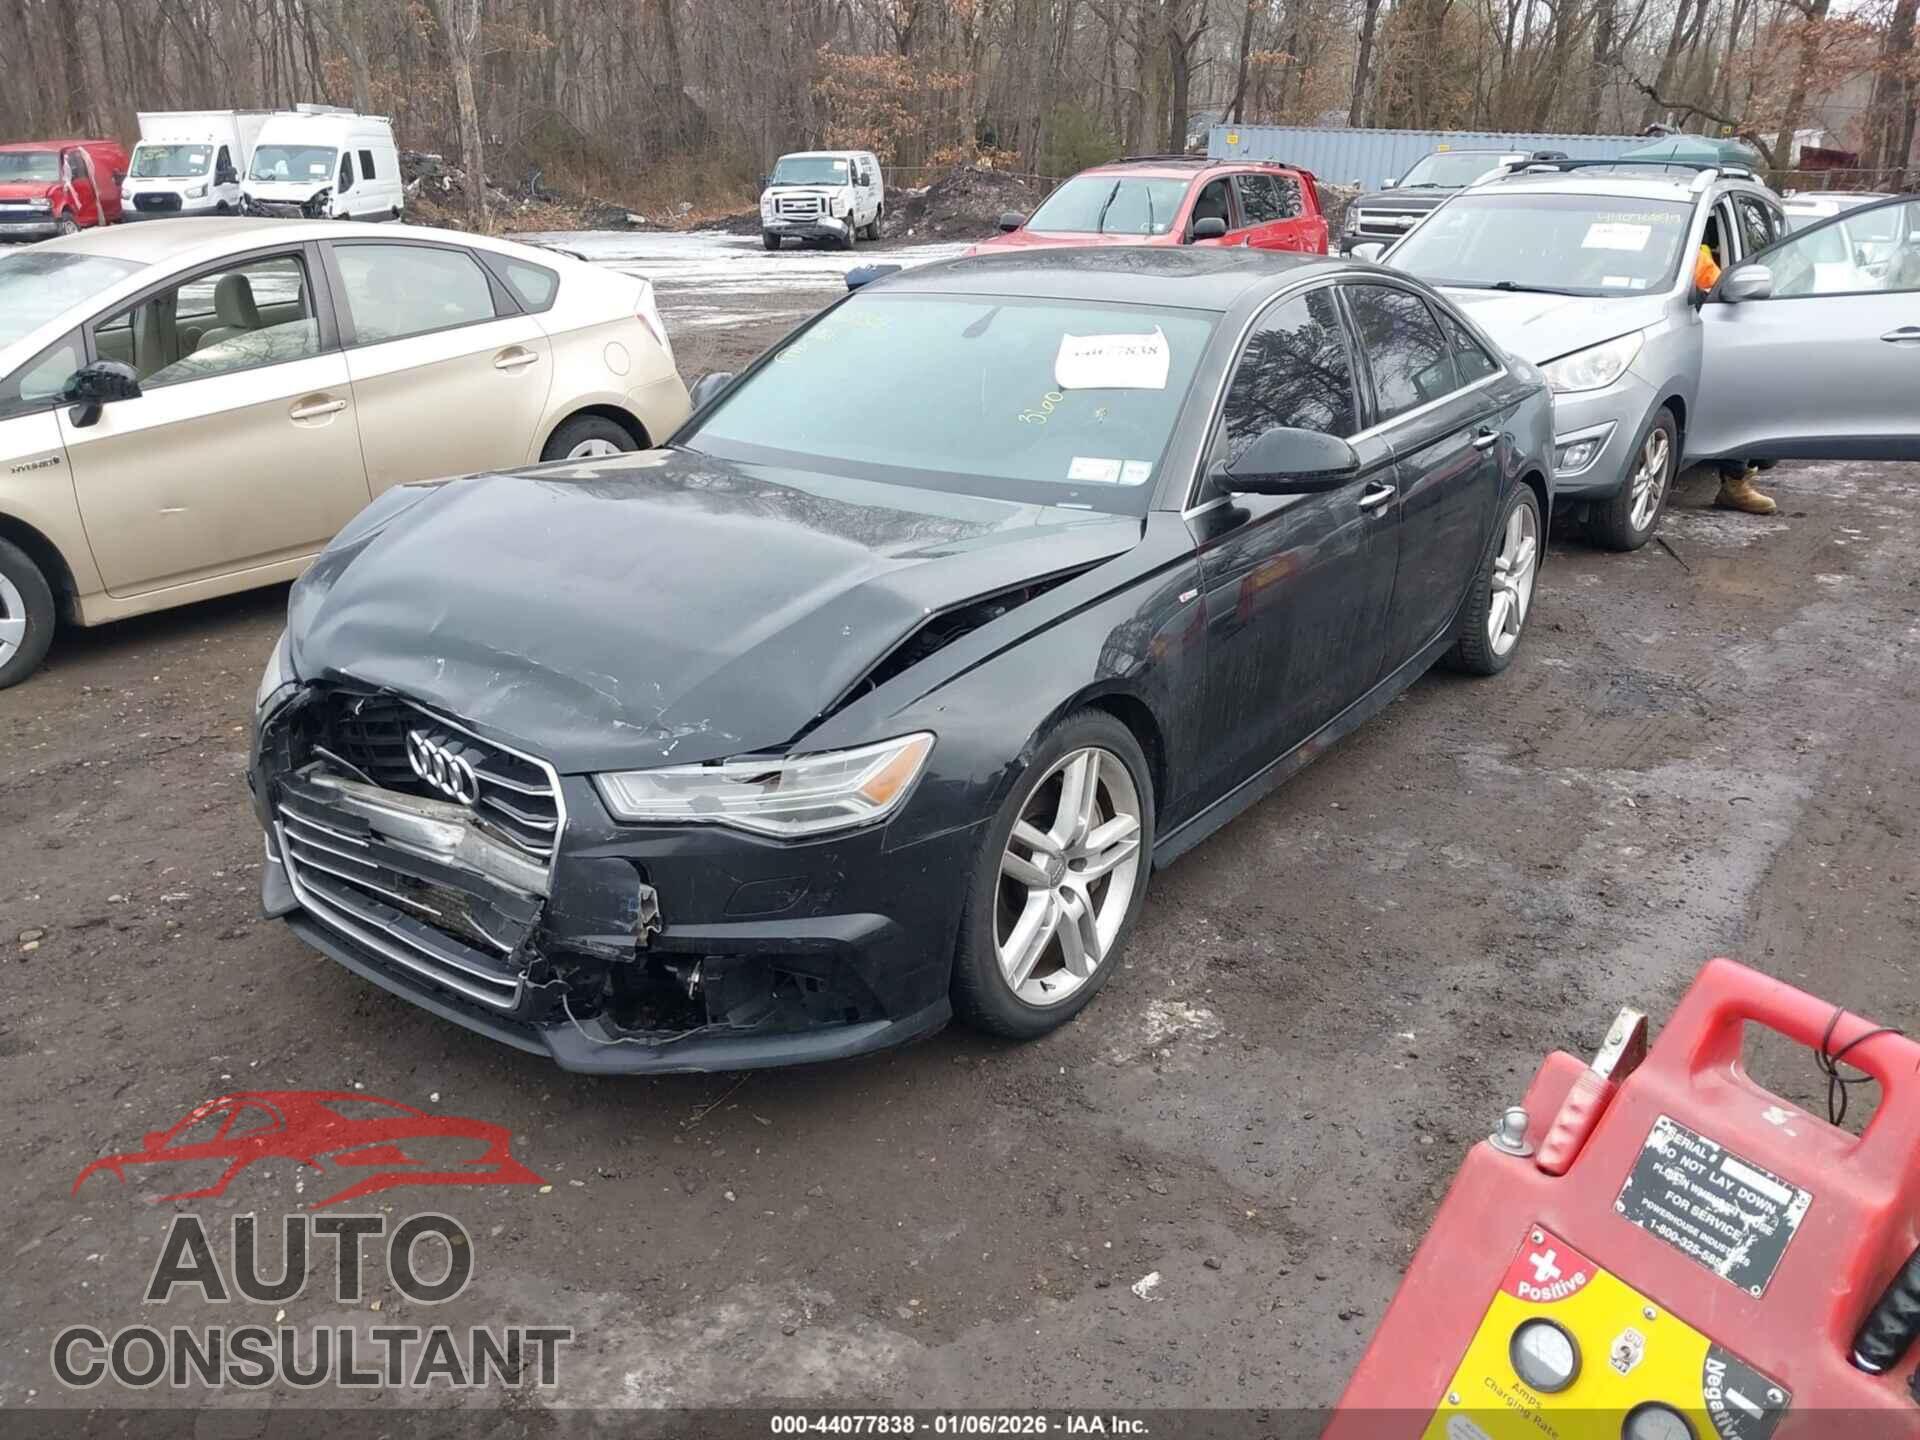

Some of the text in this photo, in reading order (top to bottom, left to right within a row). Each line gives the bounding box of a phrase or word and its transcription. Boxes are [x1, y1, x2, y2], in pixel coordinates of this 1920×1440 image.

[1665, 1126, 1707, 1159] SERIAL
[1664, 1190, 1690, 1211] FOR
[1680, 1154, 1707, 1175] NOT
[1709, 1171, 1735, 1191] LAY
[1736, 1187, 1778, 1215] DOWN
[1641, 1197, 1700, 1237] POWERHOUSE
[1517, 1270, 1588, 1302] Positive
[1483, 1376, 1560, 1440] Charging Rate
[1511, 1381, 1543, 1410] Amps
[1703, 1357, 1744, 1440] Negative
